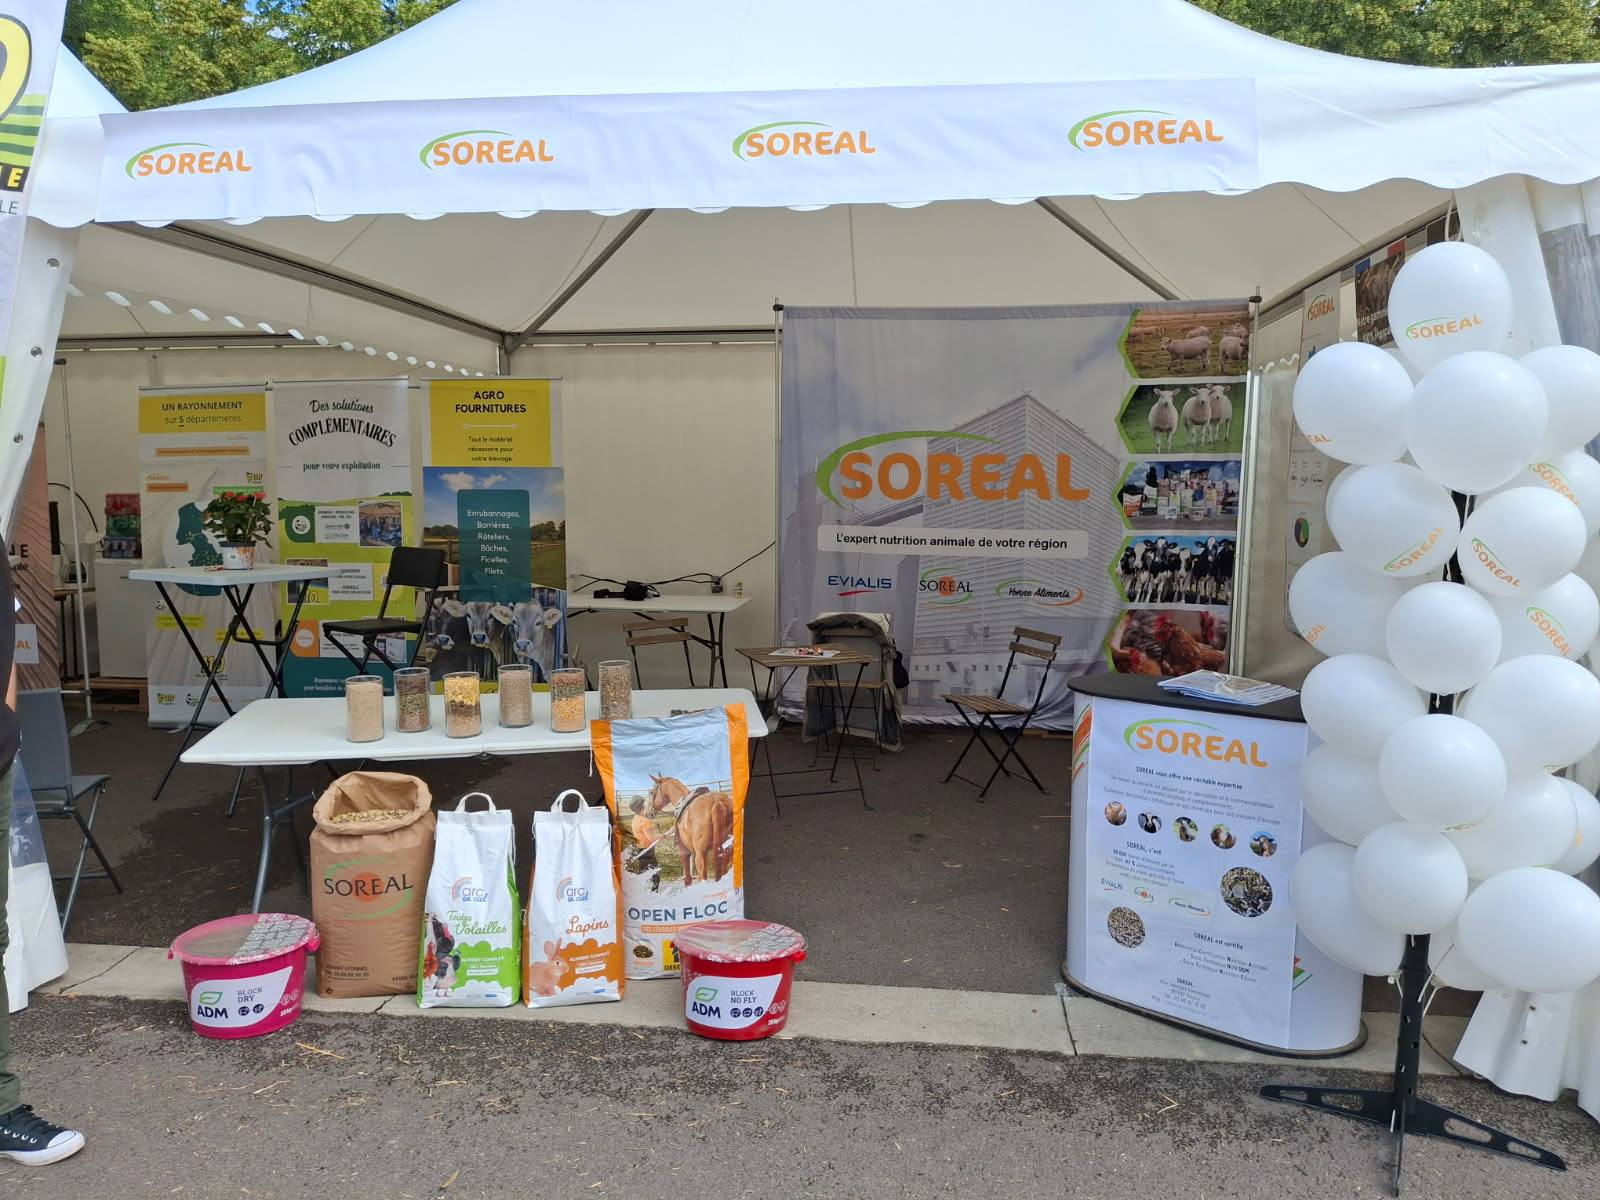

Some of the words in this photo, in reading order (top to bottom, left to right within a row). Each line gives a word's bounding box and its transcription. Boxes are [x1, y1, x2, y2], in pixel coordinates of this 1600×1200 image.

[1082, 118, 1224, 148] SOREAL
[745, 130, 876, 158] SOREAL
[432, 139, 554, 167] SOREAL
[137, 149, 252, 177] SOREAL
[1409, 314, 1484, 339] SOREAL
[473, 390, 504, 400] AGRO
[162, 403, 175, 411] UN
[177, 401, 243, 411] RAYONNEMENT
[309, 400, 329, 413] Des
[332, 399, 374, 413] solutions
[455, 404, 527, 413] FOURNITURES
[185, 414, 242, 424] départements
[303, 462, 320, 472] pour
[341, 461, 381, 472] exploitation
[839, 452, 1090, 501] SOREAL
[467, 509, 520, 518] Enrubannages,
[476, 521, 511, 530] Barrières,
[836, 533, 878, 545] L'expert
[880, 535, 927, 546] nutrition
[930, 536, 975, 547] animale
[978, 537, 993, 547] de
[995, 538, 1025, 548] votre
[1028, 538, 1068, 550] région
[1473, 543, 1521, 588] SOREAL
[828, 576, 892, 588] EVIALIS
[919, 580, 974, 592] SOREAL
[1008, 587, 1032, 596] Yonne
[1034, 587, 1071, 599] Aliments
[1135, 725, 1269, 768] SOREAL
[1136, 766, 1154, 775] SOREAL
[1217, 781, 1242, 790] expertise
[324, 873, 414, 896] SOREAL
[462, 887, 484, 897] arc
[566, 887, 585, 897] arc
[447, 910, 473, 921] Toutes
[628, 907, 676, 921] OPEN
[683, 901, 728, 920] FLOC
[455, 921, 507, 935] Volailles
[565, 915, 609, 937] Lapins
[1194, 932, 1213, 943] SOREAL
[237, 987, 263, 997] BLOCK
[237, 995, 255, 1003] DRY
[197, 1005, 228, 1018] ADM
[692, 1002, 721, 1018] ADM
